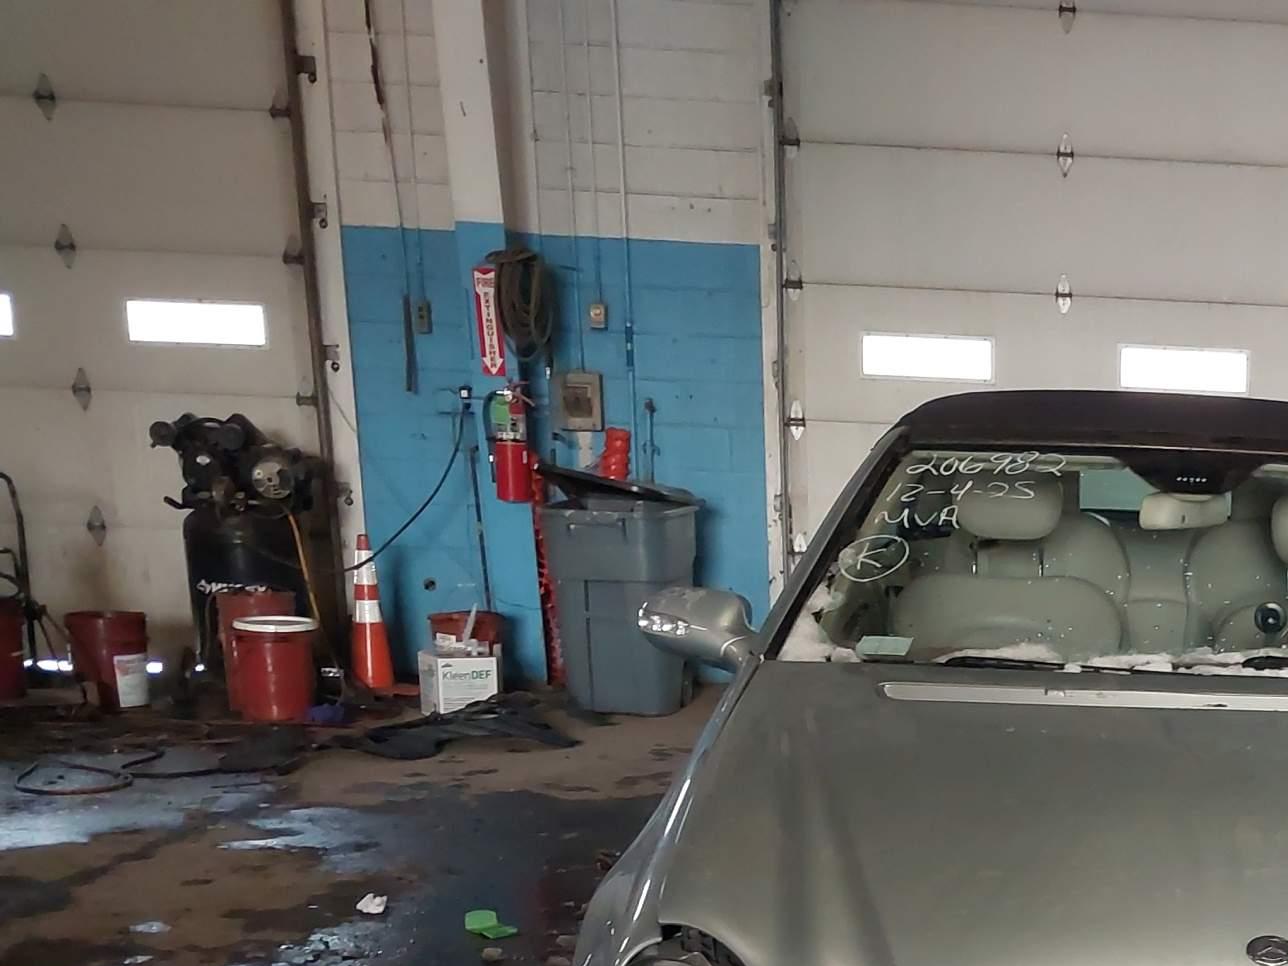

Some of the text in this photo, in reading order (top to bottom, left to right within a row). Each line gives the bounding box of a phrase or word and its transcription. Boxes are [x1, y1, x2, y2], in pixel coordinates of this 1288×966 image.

[477, 278, 496, 288] FIRE
[483, 292, 497, 368] EXTINGUISHER
[906, 451, 1066, 477] 206982
